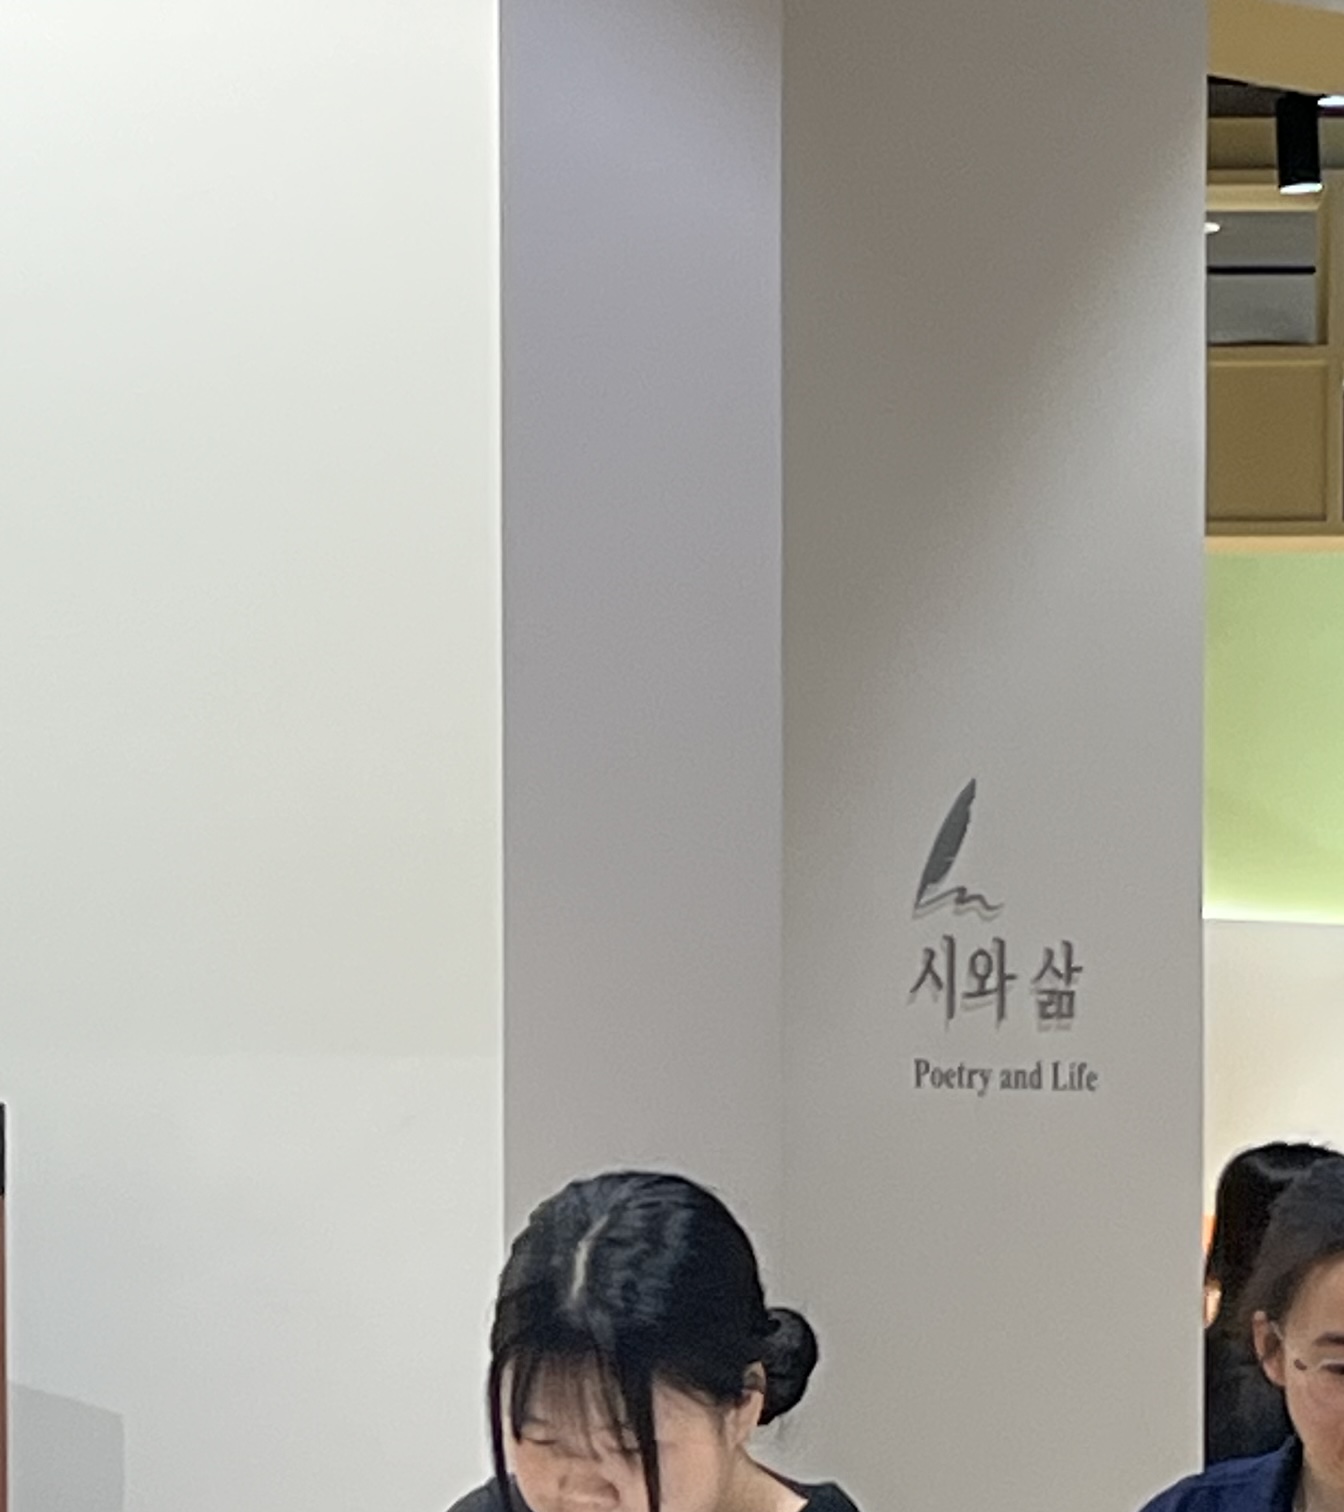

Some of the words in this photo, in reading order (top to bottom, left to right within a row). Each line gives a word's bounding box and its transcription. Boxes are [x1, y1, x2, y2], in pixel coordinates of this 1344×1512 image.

[909, 933, 1018, 1021] 시와
[1029, 939, 1084, 1021] 삶
[913, 1056, 993, 1098] Poetry
[999, 1061, 1043, 1091] and
[1051, 1061, 1099, 1093] Life
